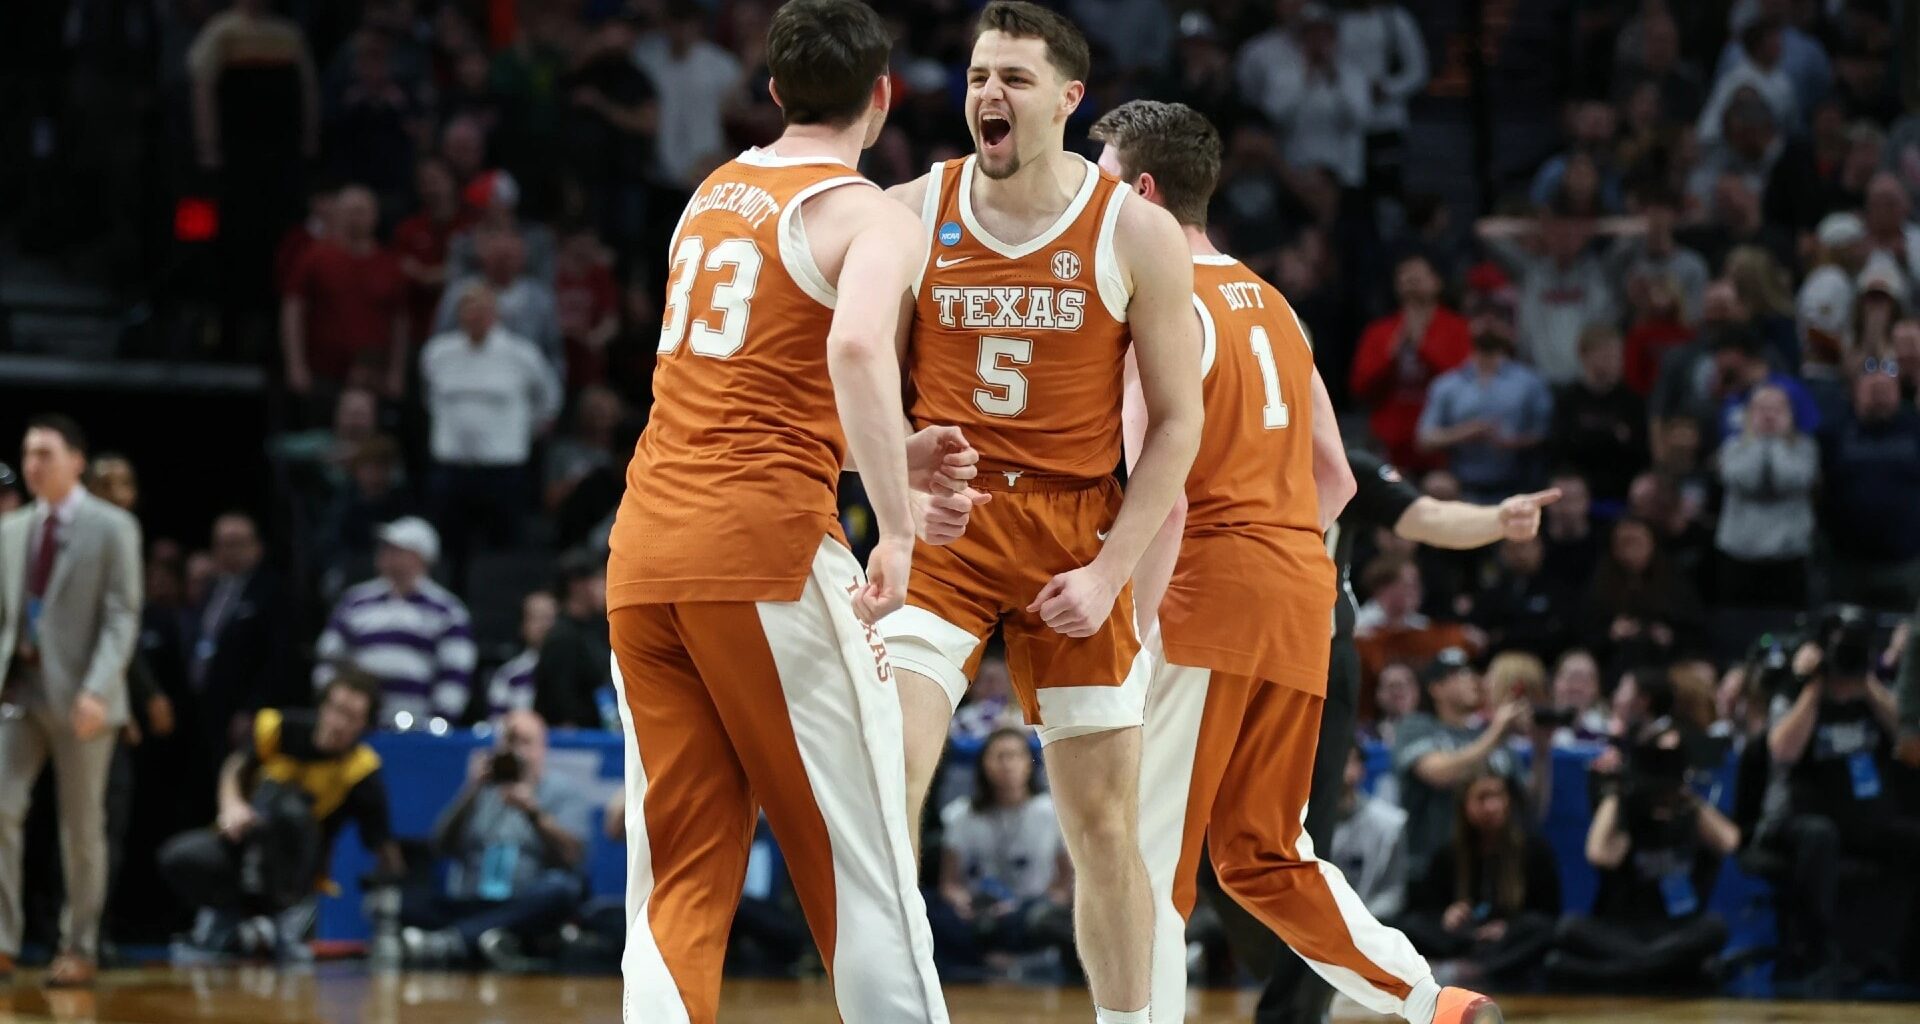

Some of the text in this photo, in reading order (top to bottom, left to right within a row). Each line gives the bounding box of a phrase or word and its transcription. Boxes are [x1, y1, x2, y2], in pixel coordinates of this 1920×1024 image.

[941, 232, 960, 240] NCAA
[1053, 251, 1080, 280] SEC
[657, 236, 764, 361] 33
[932, 286, 1086, 331] TEXAS
[1218, 282, 1265, 311] BOTT
[973, 335, 1033, 418] 5
[1250, 325, 1289, 429] 1
[845, 575, 893, 682] TXAS
